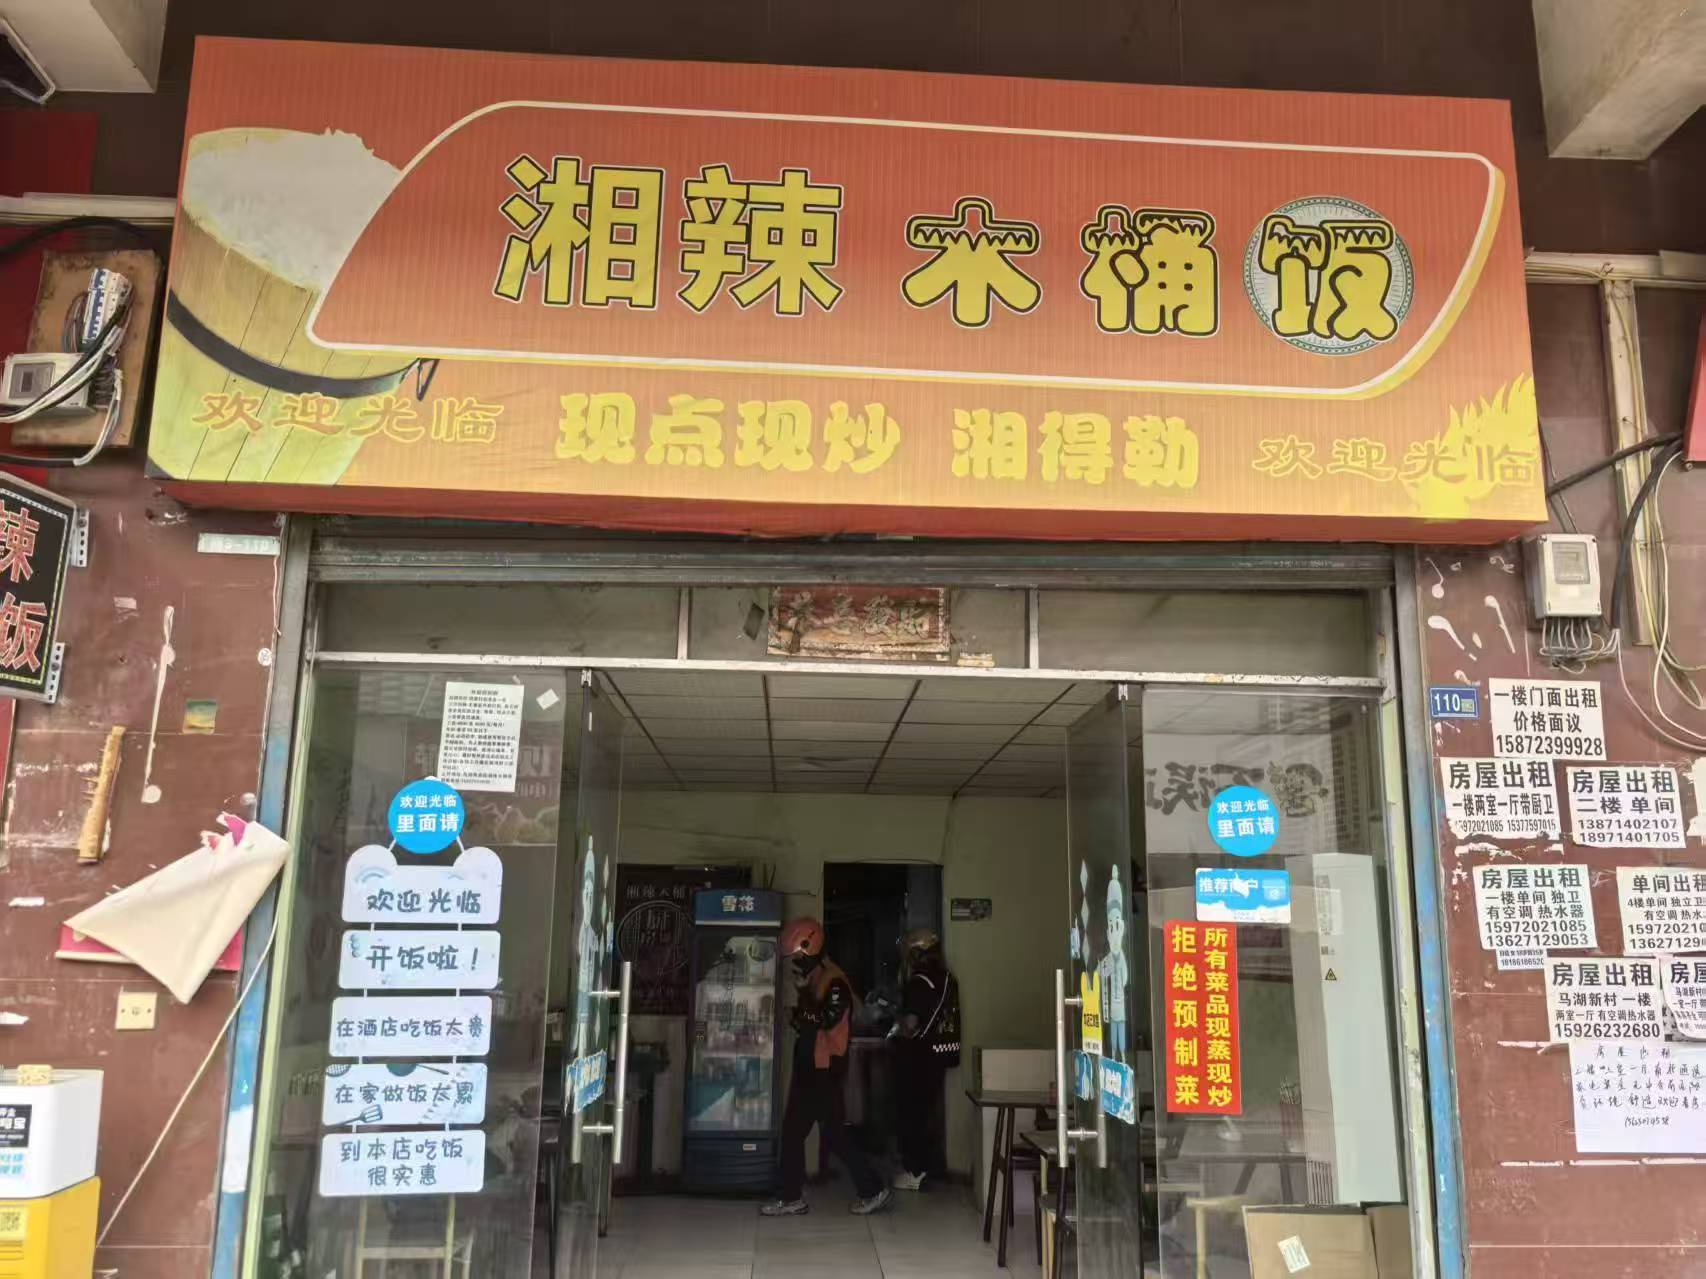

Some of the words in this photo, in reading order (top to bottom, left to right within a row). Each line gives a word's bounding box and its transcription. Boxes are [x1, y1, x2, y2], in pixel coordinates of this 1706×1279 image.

[191, 391, 505, 446] 欢迎光临
[556, 392, 900, 476] 现点现炒
[951, 407, 1200, 489] 湘得勒
[1251, 434, 1538, 488] 欢迎光临
[1433, 693, 1461, 712] 110
[1494, 685, 1599, 709] 一楼门面出租
[1513, 710, 1582, 733] 价格面议
[1496, 734, 1603, 756] 15872399928
[1449, 761, 1553, 790] 房屋出租
[1572, 769, 1676, 793] 房屋出租
[399, 794, 457, 809] 欢迎光临
[1216, 798, 1270, 815] 欢迎光临
[1452, 793, 1555, 816] 一楼两室一厅带厨卫
[1577, 797, 1622, 815] 二楼
[1630, 797, 1676, 815] 单间
[396, 812, 460, 833] 里面请
[1217, 816, 1276, 838] 里面请
[1578, 818, 1678, 830] 13871402107
[1579, 831, 1680, 843] 18971401705
[1481, 867, 1582, 889] 房屋出租
[366, 888, 481, 914] 欢迎光临
[1485, 890, 1546, 905] 一楼单间
[1551, 890, 1581, 904] 独卫
[1486, 905, 1533, 920] 有空调
[1538, 904, 1584, 919] 热水器
[1681, 909, 1706, 920] 热水
[1485, 920, 1587, 934] 15972021085
[1486, 933, 1589, 947] 13627129053
[1552, 962, 1654, 987] 房屋出租
[1557, 992, 1617, 1007] 马湖新村
[1622, 992, 1652, 1007] 一楼
[336, 1014, 485, 1038] 在酒店吃饭太贵
[1171, 924, 1201, 1106] 拒绝预制菜
[1203, 926, 1233, 1107] 所有菜品现蒸现炒
[1555, 1009, 1595, 1021] 两室一厅
[1597, 1009, 1656, 1021] 有空调热水器
[1554, 1023, 1660, 1038] 15926232680
[335, 1081, 475, 1105] 在家做饭太累
[340, 1137, 464, 1162] 到本店吃饭
[367, 1162, 438, 1186] 很实惠
